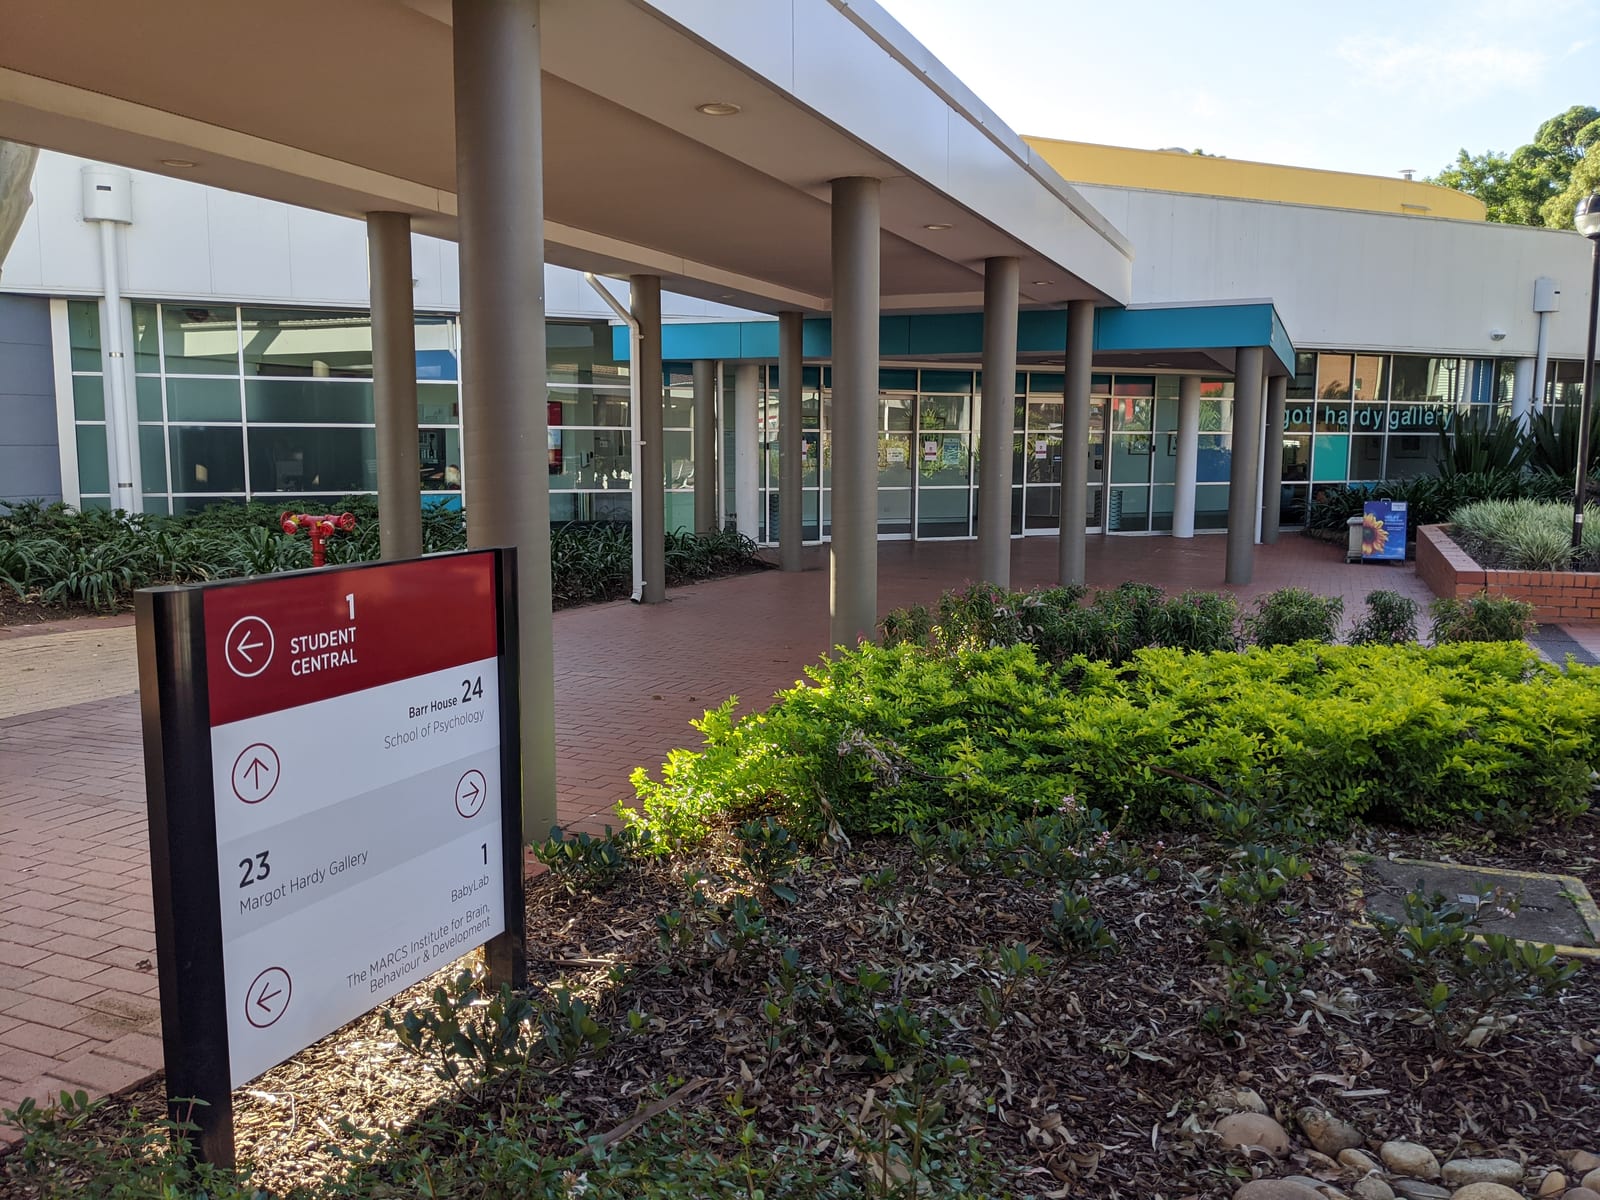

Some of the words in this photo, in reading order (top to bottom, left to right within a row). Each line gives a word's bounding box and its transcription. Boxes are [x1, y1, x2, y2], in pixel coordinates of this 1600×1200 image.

[1325, 406, 1382, 429] hardy
[346, 593, 355, 620] 1
[291, 627, 357, 654] STUDENT
[291, 649, 358, 676] CENTRAL
[408, 704, 429, 719] Barr
[430, 696, 458, 713] House
[461, 676, 484, 703] 24
[384, 728, 418, 750] School
[421, 725, 431, 739] of
[433, 709, 485, 734] Psychology
[239, 850, 270, 888] 23
[481, 843, 488, 865] 1
[240, 883, 286, 915] Margot
[290, 868, 325, 893] Hardy
[329, 851, 368, 876] Gallery
[451, 874, 489, 903] BabyLab
[347, 970, 367, 989] The
[369, 945, 408, 973] MARCS
[411, 924, 449, 954] Institute
[451, 916, 464, 931] for
[370, 957, 421, 993] Behaviour
[423, 947, 431, 962] &
[432, 916, 491, 957] Development
